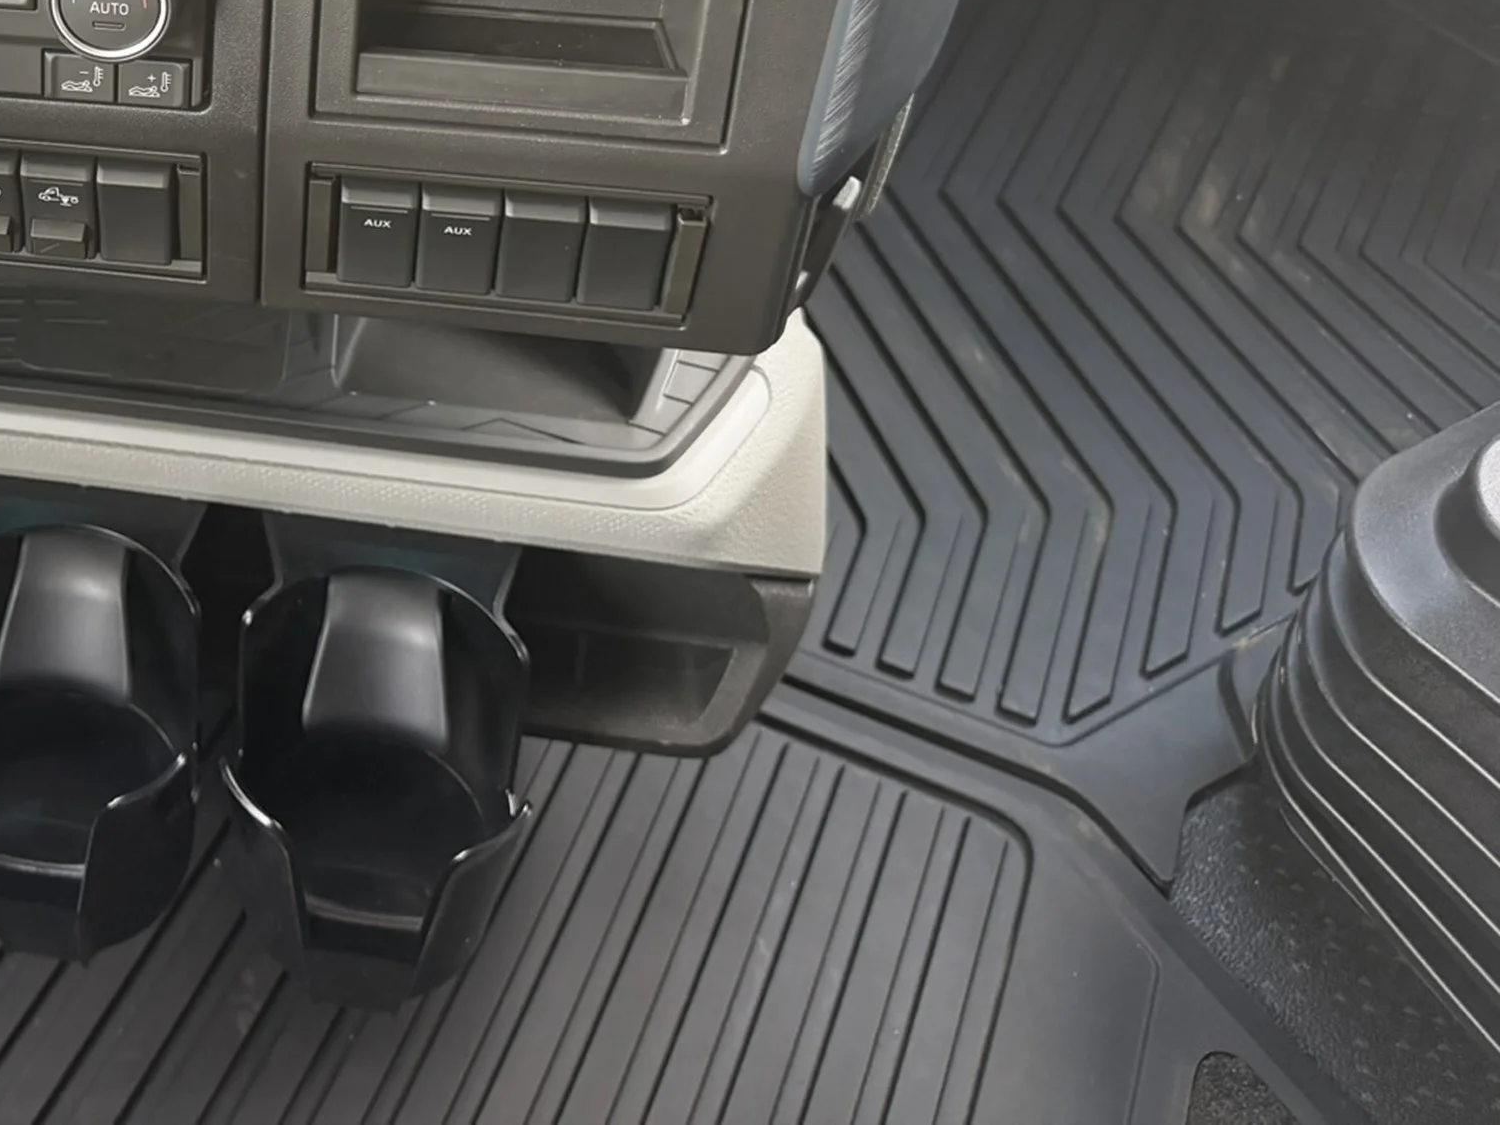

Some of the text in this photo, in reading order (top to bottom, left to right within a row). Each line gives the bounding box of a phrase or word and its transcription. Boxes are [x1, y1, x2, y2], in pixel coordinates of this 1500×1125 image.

[89, 0, 129, 16] AUTO
[364, 218, 391, 228] AUX
[443, 226, 472, 236] AUX
